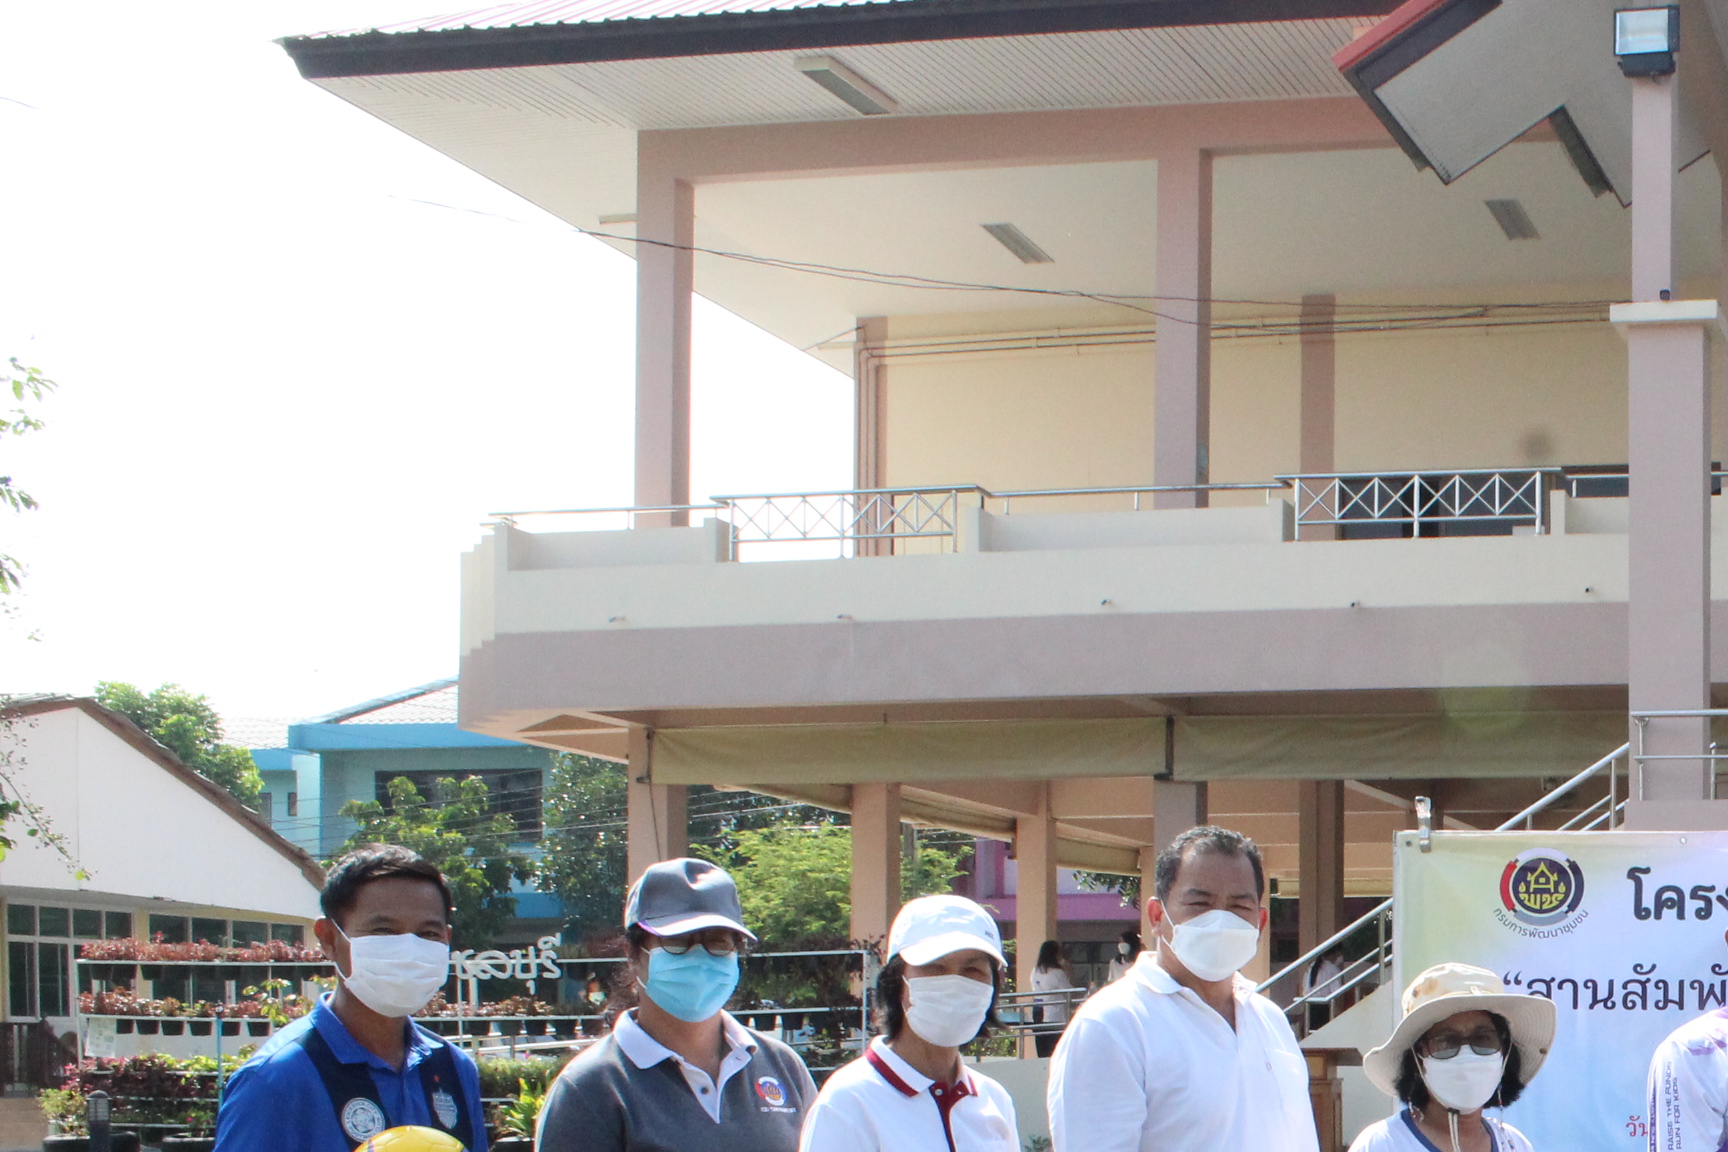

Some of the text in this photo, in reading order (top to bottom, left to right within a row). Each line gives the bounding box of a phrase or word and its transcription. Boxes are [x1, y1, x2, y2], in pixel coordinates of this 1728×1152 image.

[1493, 908, 1590, 939] กรมการพัฒนาชุมชน
[1672, 1105, 1682, 1124] FOR
[1665, 1121, 1674, 1151] RAISE
[1674, 1127, 1683, 1150] RUN
